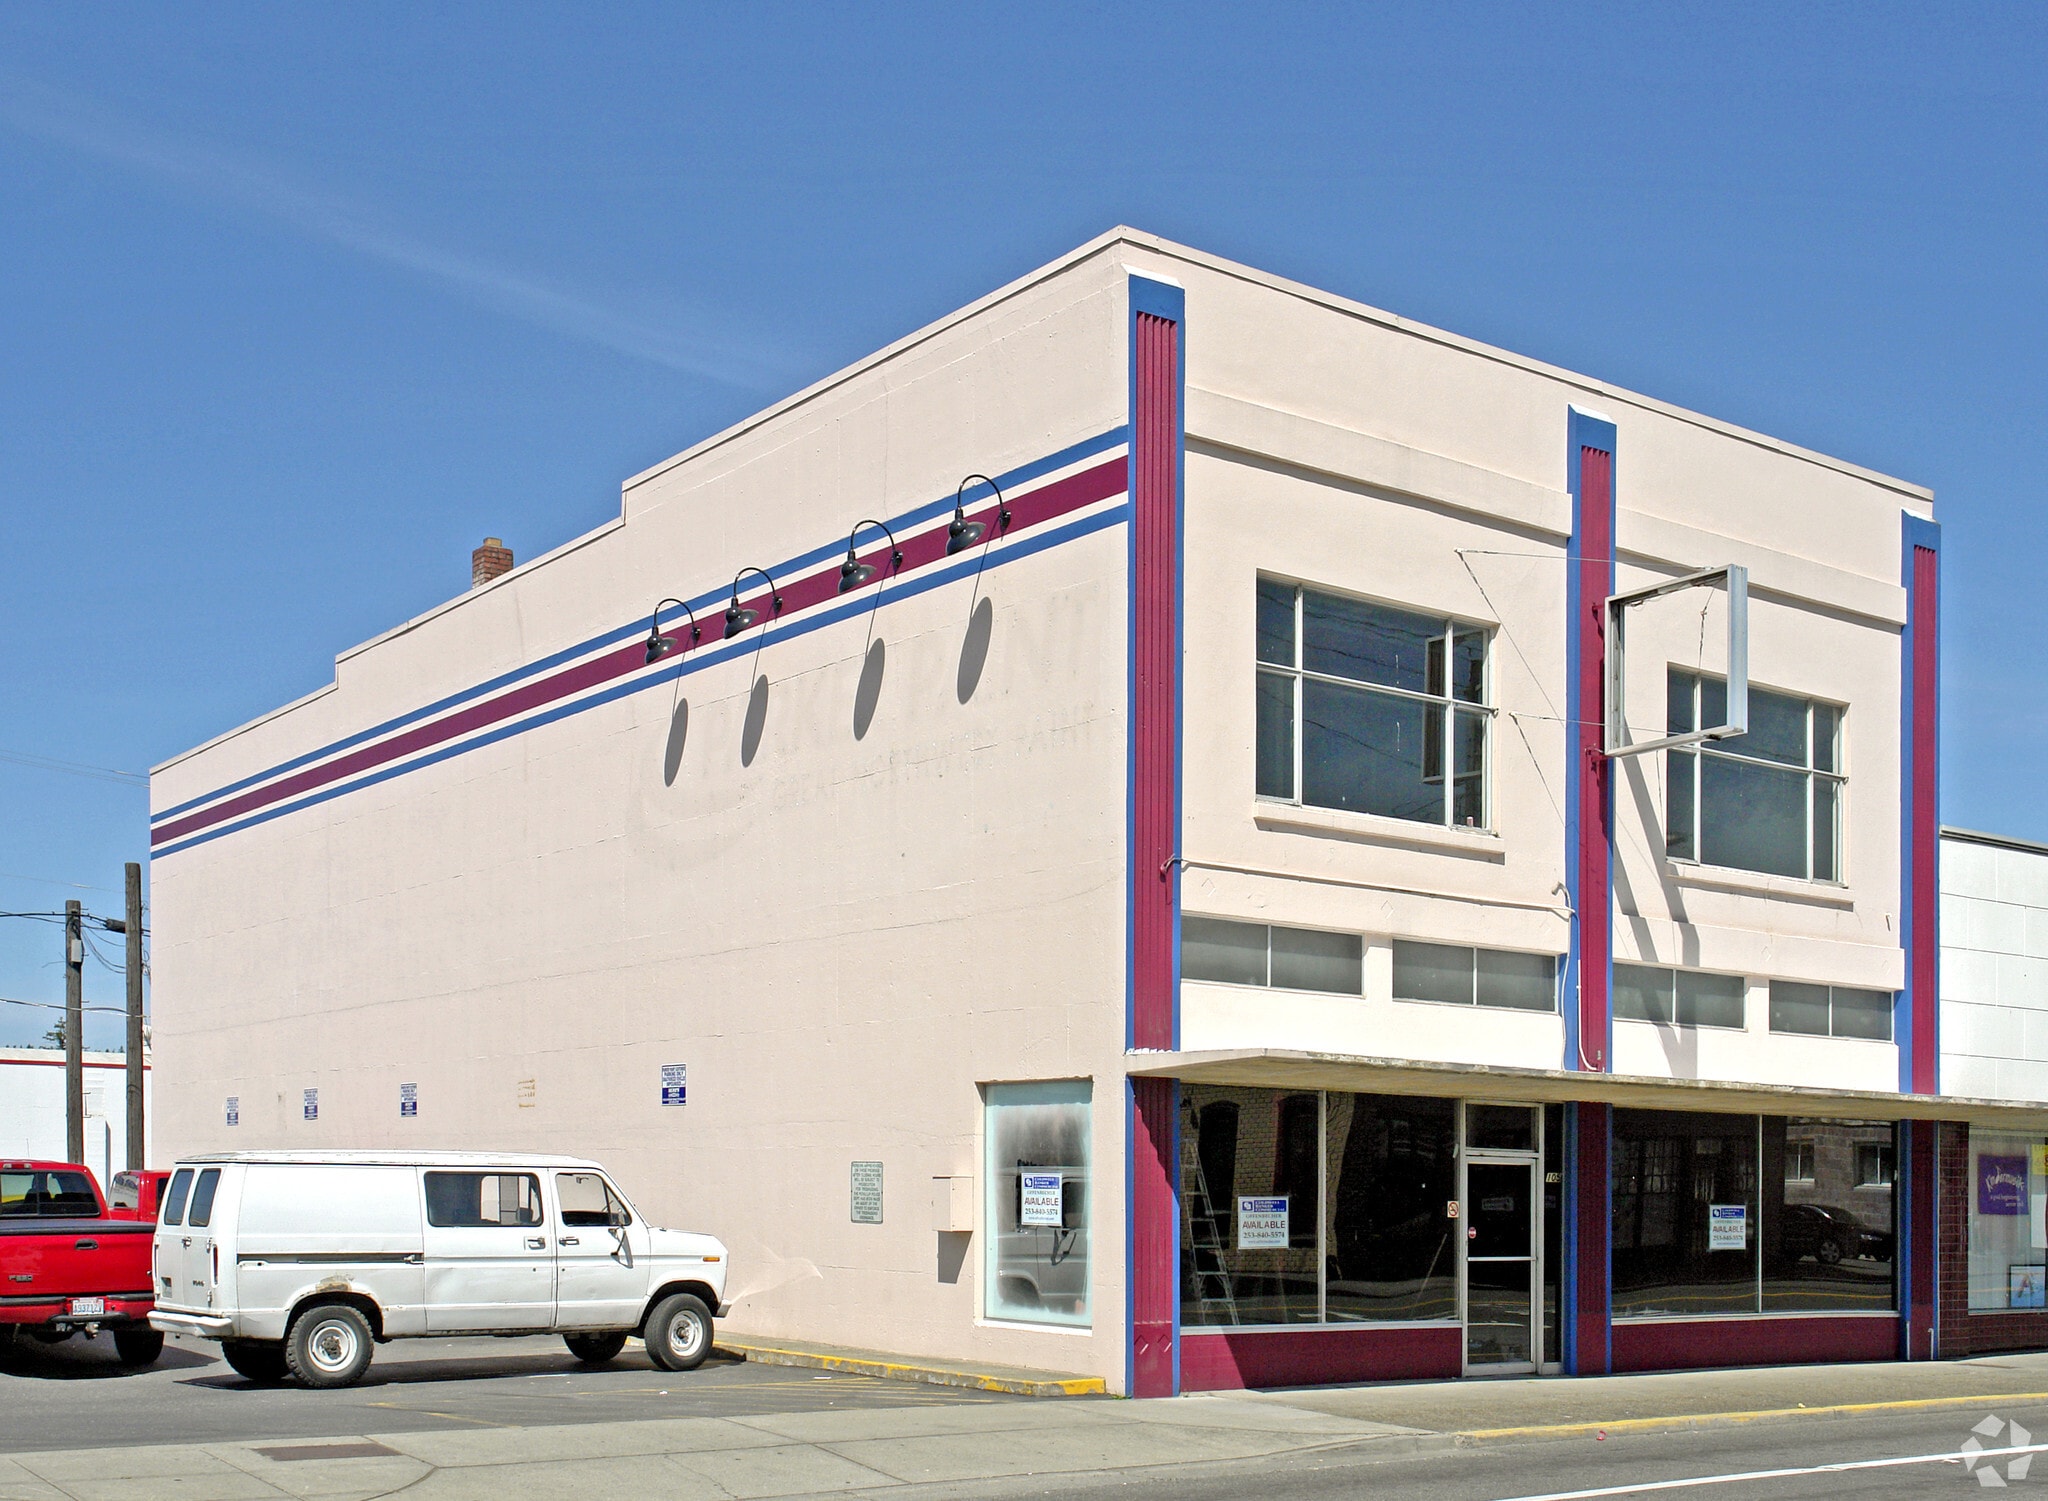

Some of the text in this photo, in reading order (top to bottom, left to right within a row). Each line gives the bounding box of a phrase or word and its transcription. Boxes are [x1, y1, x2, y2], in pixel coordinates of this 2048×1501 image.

[1024, 1197, 1059, 1206] AVAILABLE
[1242, 1220, 1286, 1229] AVAILABLE
[1713, 1225, 1744, 1233] AVAILABLE
